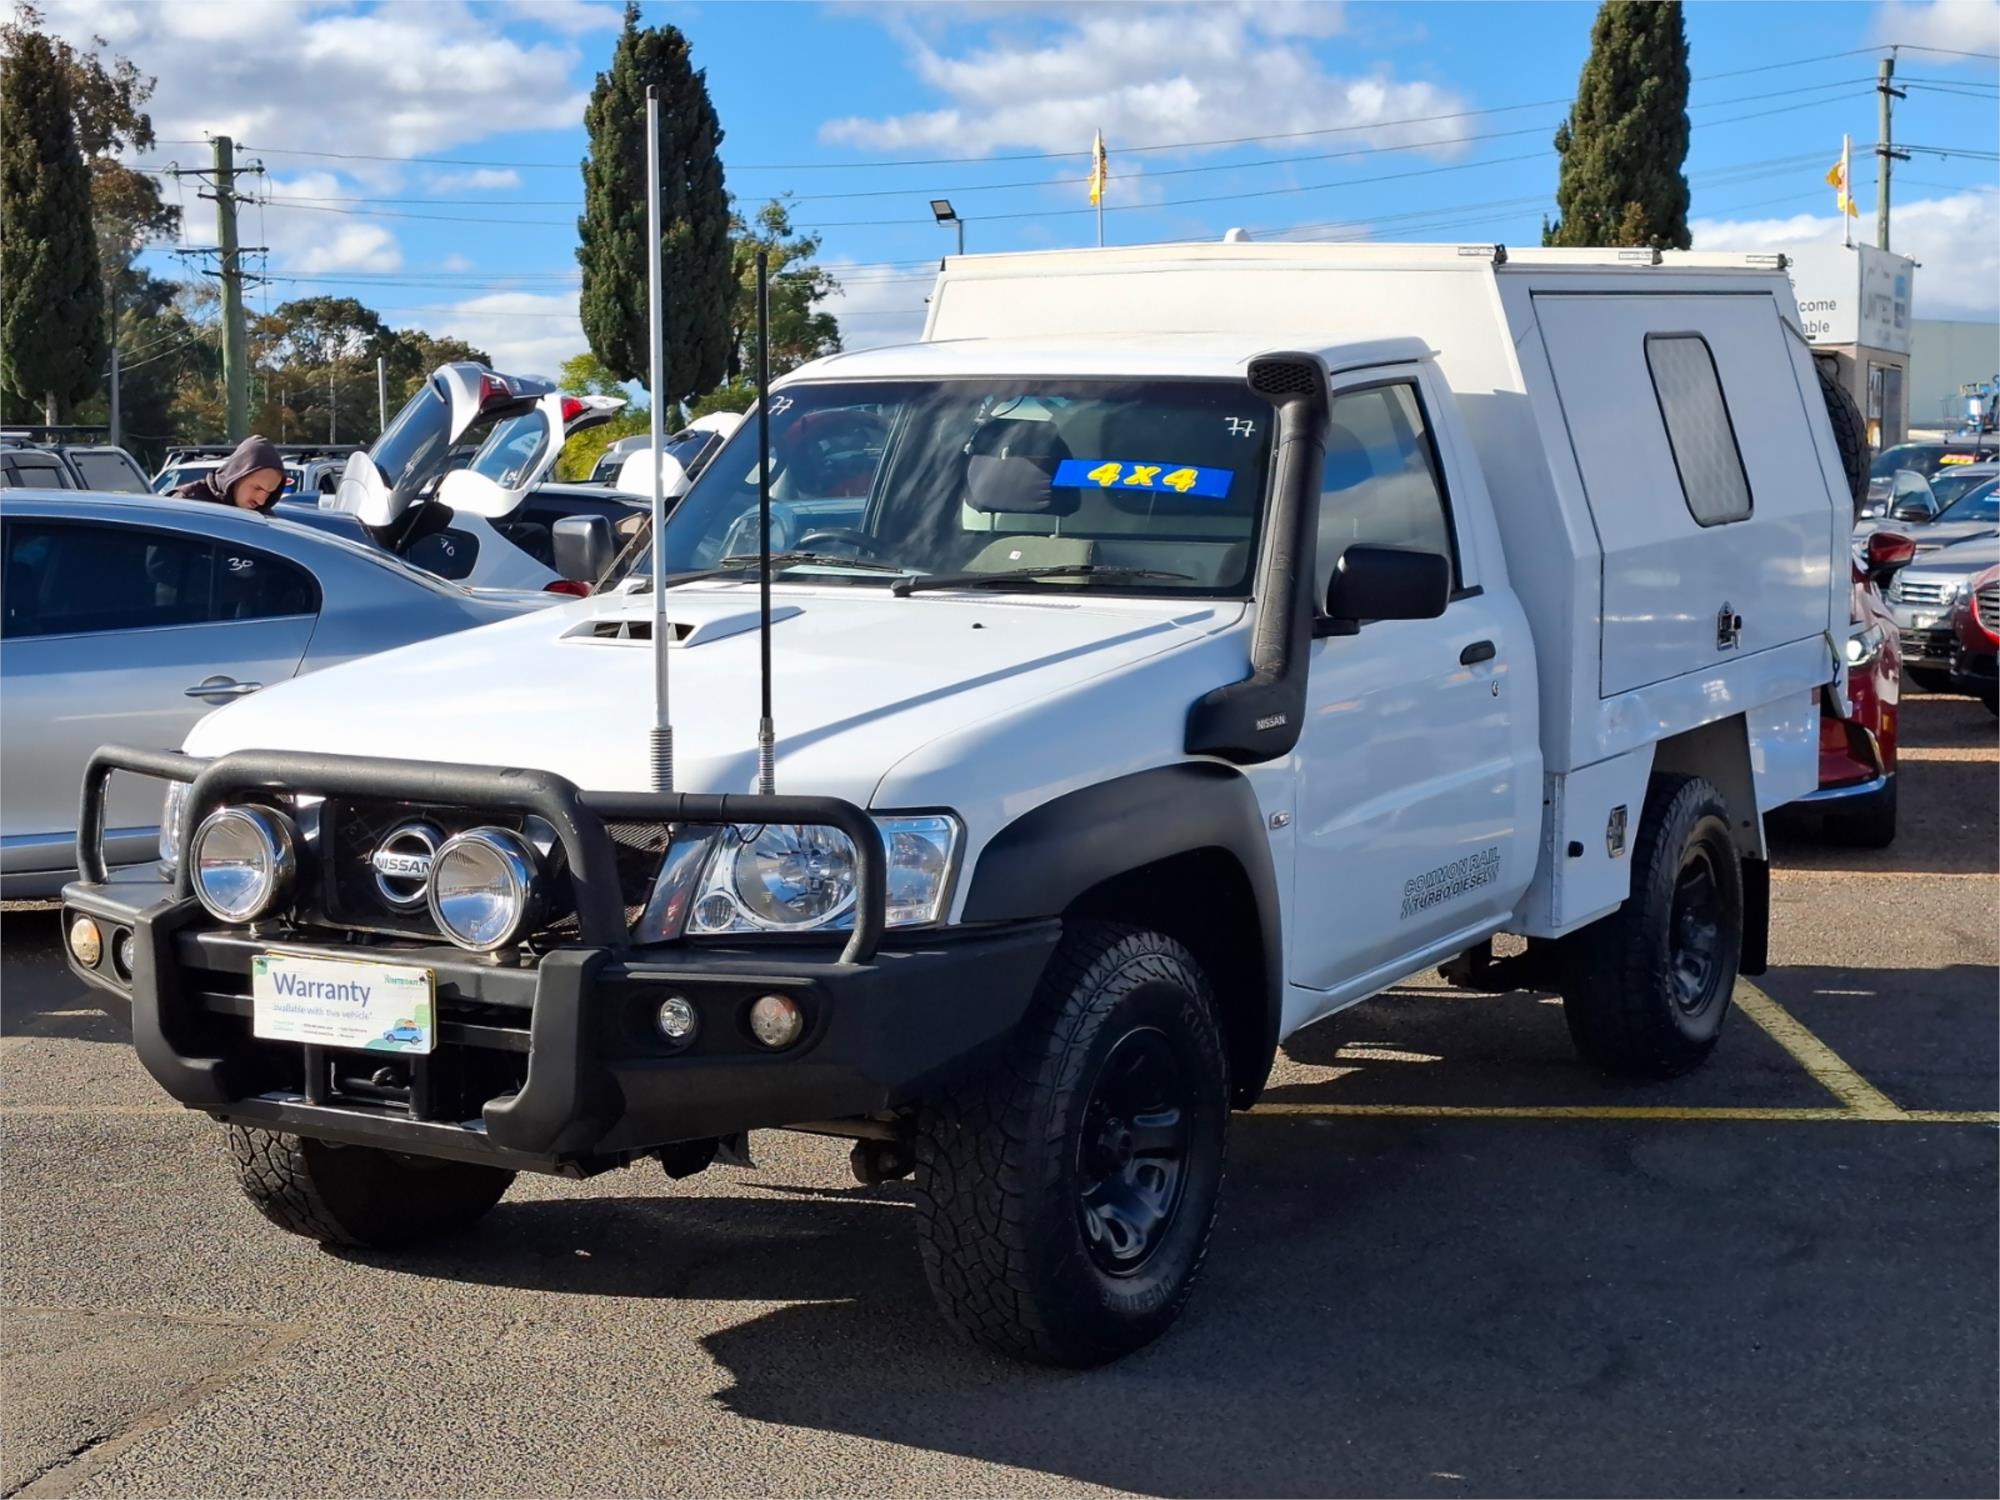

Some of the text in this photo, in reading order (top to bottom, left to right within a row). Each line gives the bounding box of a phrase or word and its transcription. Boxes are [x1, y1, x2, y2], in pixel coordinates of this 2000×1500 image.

[1799, 300, 1837, 312] come
[768, 395, 794, 416] 77
[1224, 416, 1256, 437] 77
[227, 557, 254, 571] 30
[1256, 714, 1286, 731] NISSAN
[374, 857, 430, 874] NISSAN
[1404, 846, 1501, 897] COMMON RAIL
[272, 971, 372, 1008] Warranty
